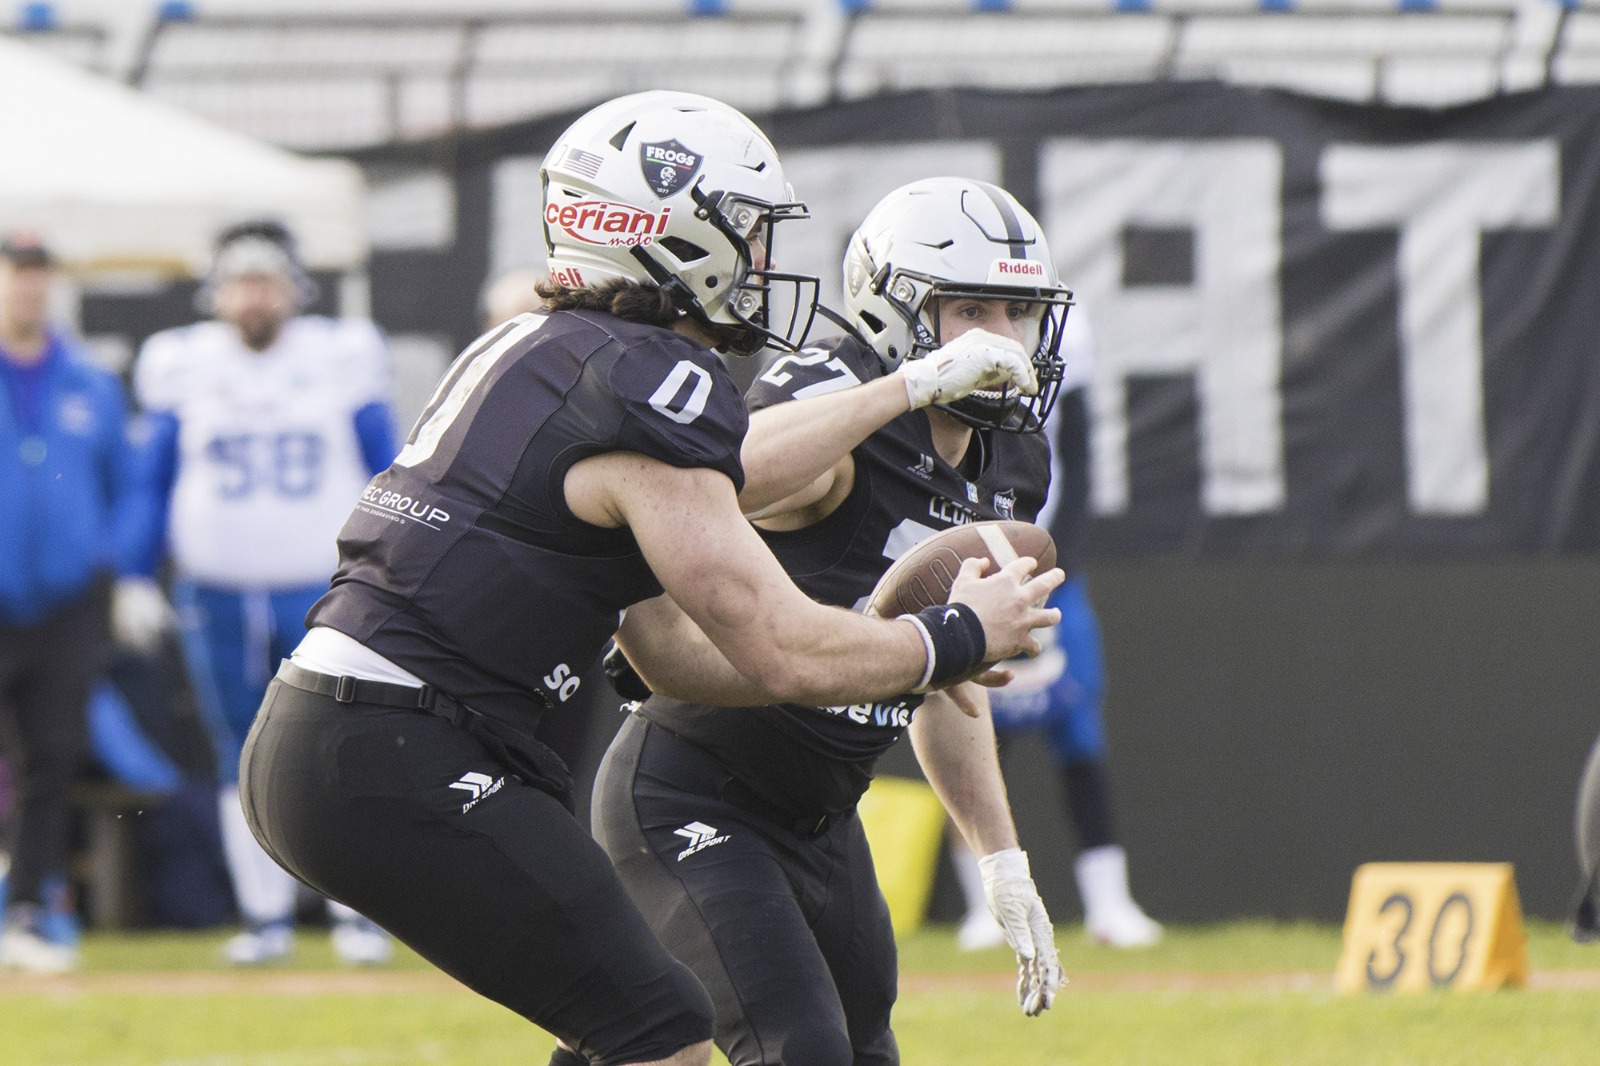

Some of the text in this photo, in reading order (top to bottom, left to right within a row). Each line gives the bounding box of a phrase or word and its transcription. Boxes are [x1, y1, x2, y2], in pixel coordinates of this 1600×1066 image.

[646, 145, 696, 167] FROGS
[545, 202, 671, 235] ceriani
[608, 230, 652, 246] moto
[550, 266, 586, 289] dell
[998, 261, 1043, 276] Riddell
[759, 347, 862, 401] 27
[648, 359, 714, 425] 0
[206, 432, 326, 500] 58
[378, 490, 451, 523] GROUP
[1365, 892, 1475, 990] 30
